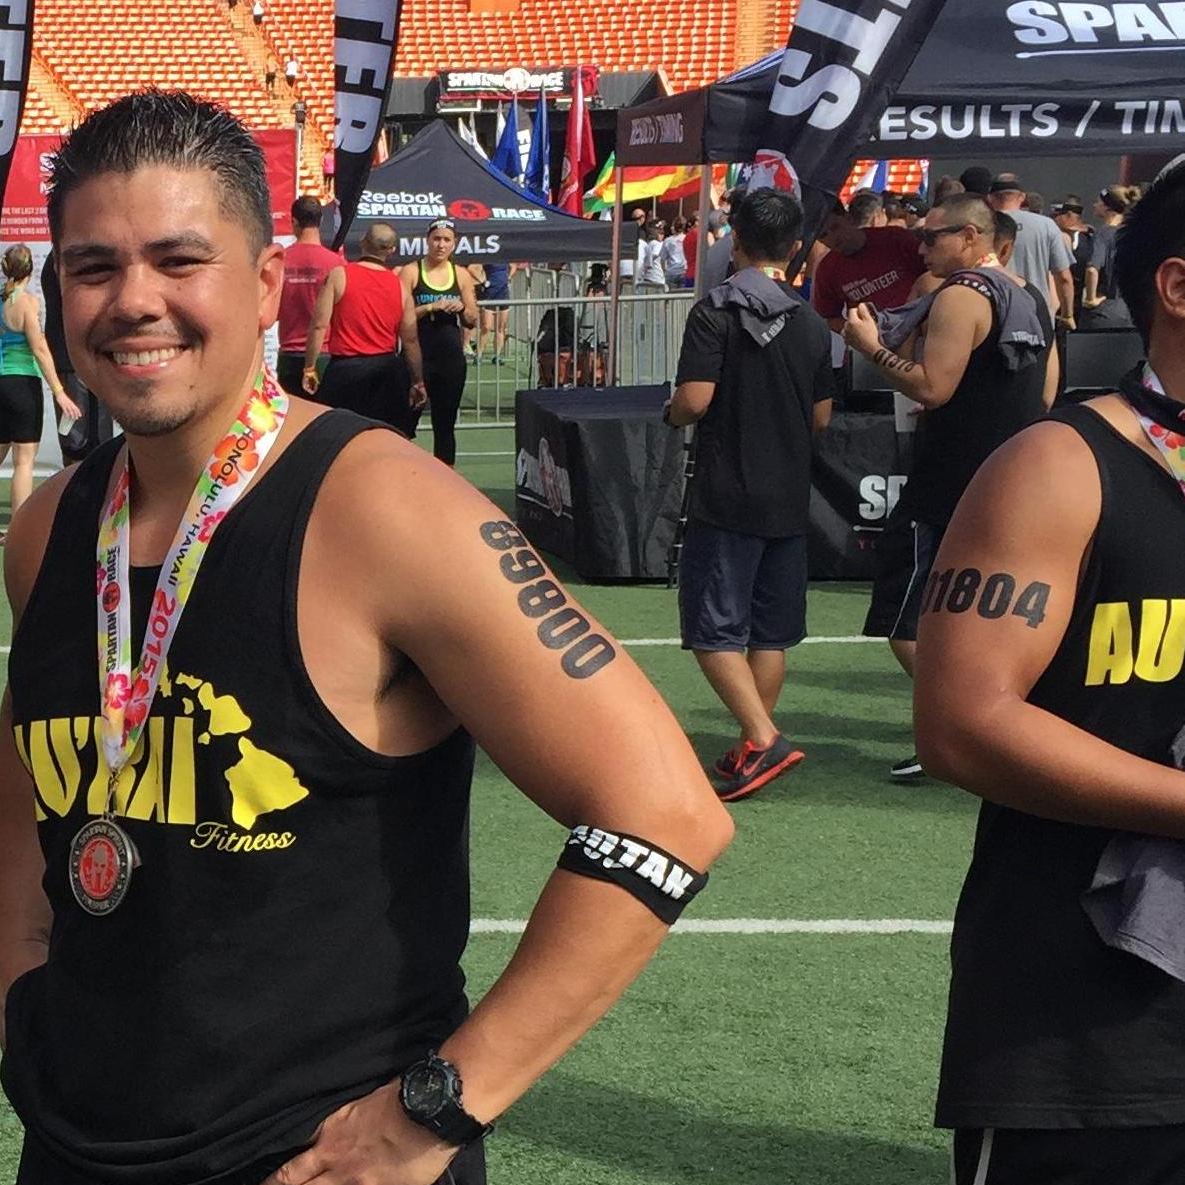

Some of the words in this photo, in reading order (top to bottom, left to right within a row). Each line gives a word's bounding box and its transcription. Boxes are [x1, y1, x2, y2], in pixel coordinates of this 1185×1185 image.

[870, 102, 1060, 141] ESULTS
[356, 203, 447, 217] SPARTAN
[491, 206, 544, 219] RACE
[399, 235, 501, 256] MALS
[167, 522, 201, 587] HAWAII
[106, 612, 117, 673] SPARTAN
[141, 587, 176, 679] 2015
[190, 821, 297, 853] Fitness
